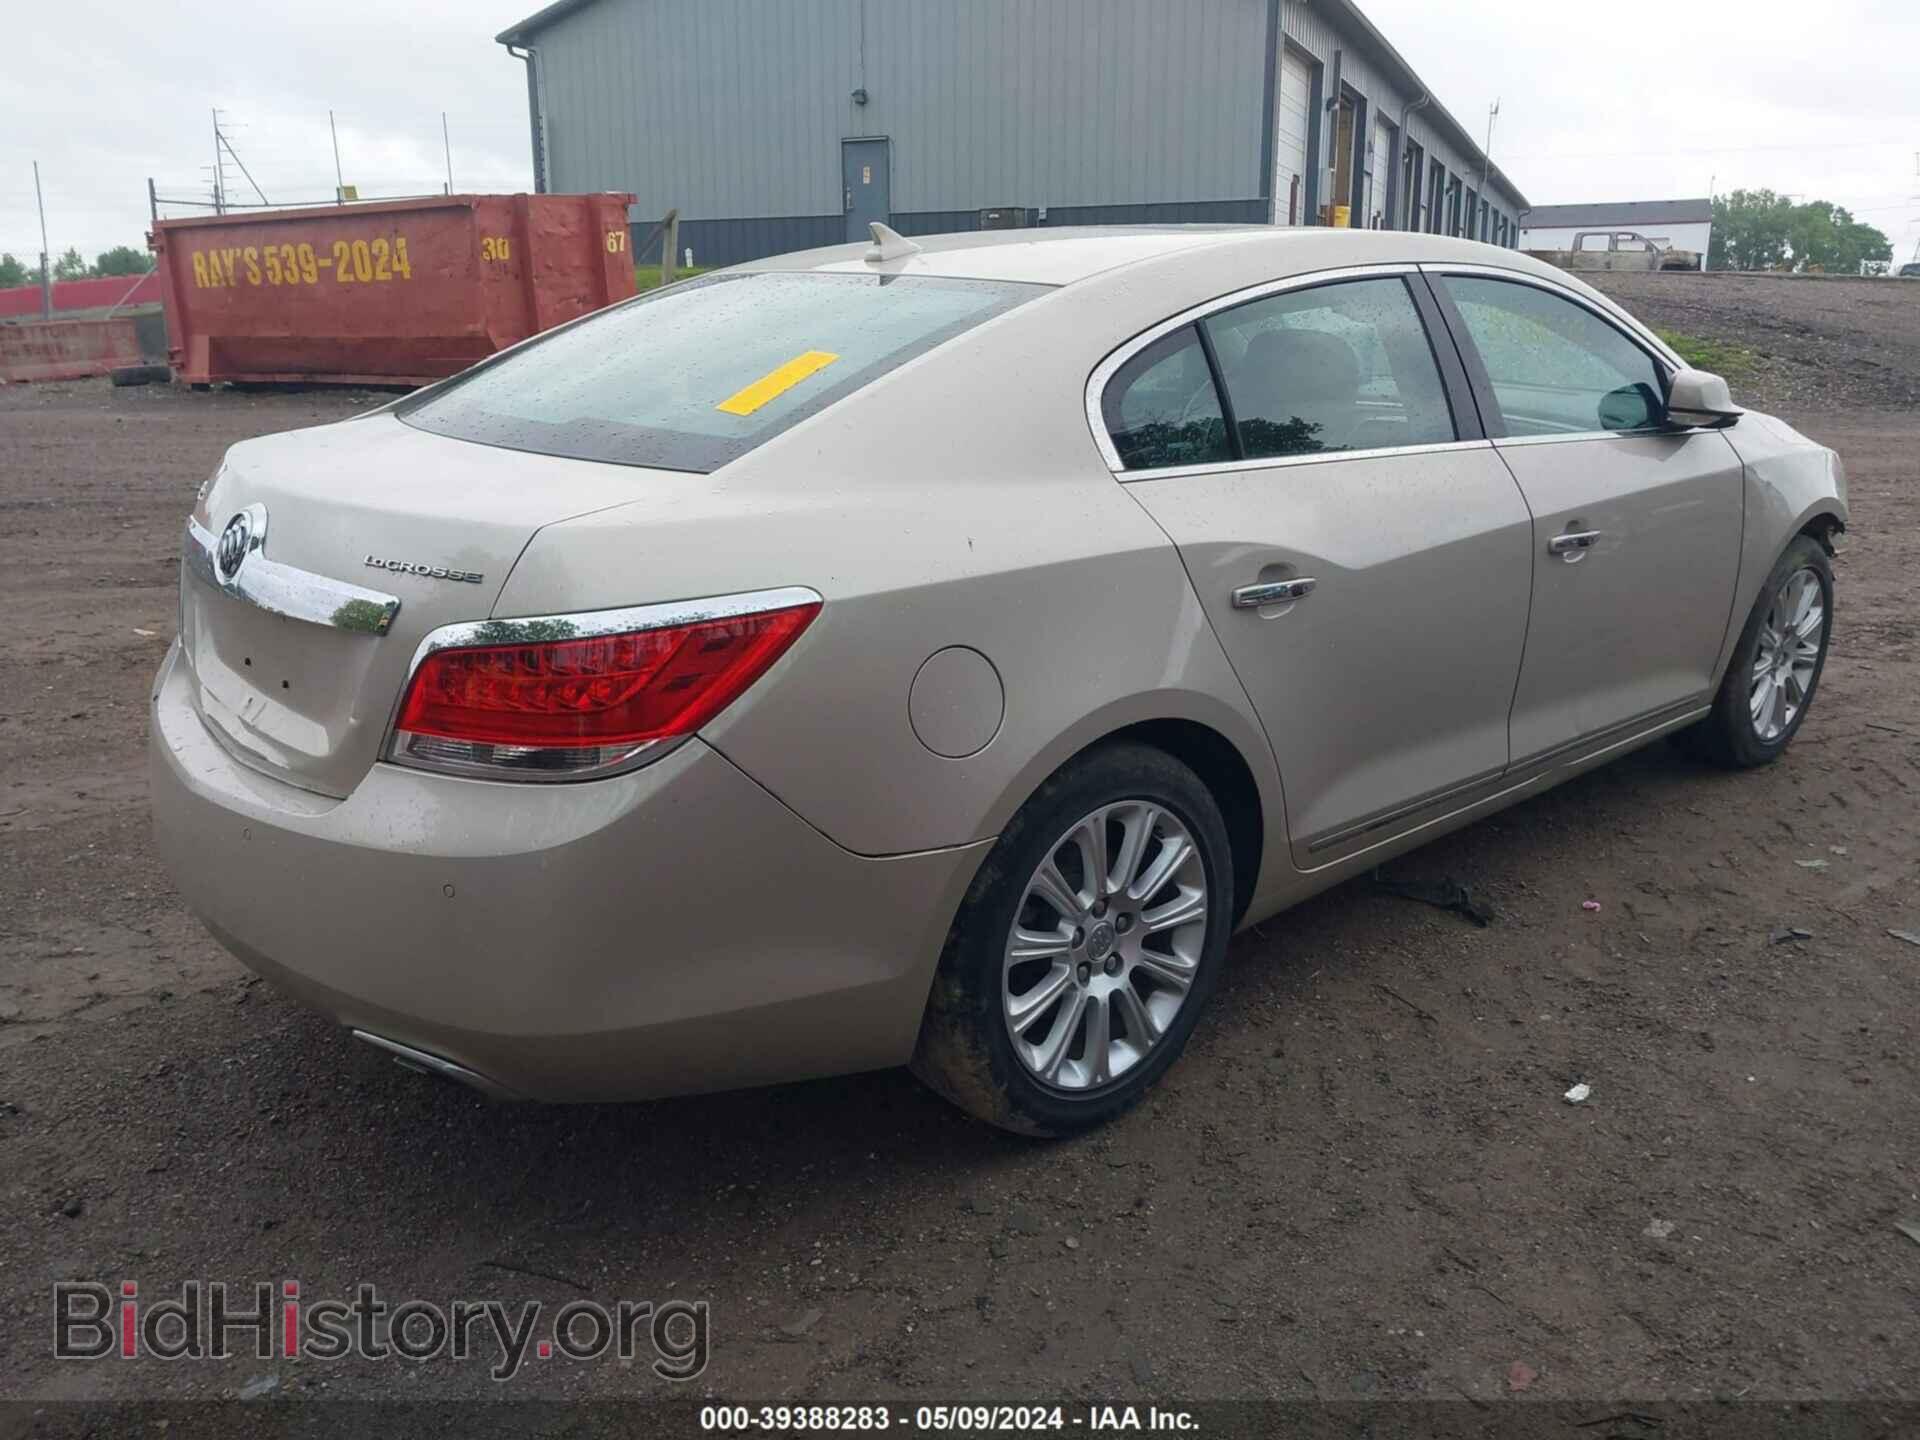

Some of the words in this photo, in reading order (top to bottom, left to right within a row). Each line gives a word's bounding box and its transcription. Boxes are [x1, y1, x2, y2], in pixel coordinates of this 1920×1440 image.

[607, 231, 625, 253] 67
[192, 246, 262, 288] RAY'S
[263, 238, 412, 286] 539-2024
